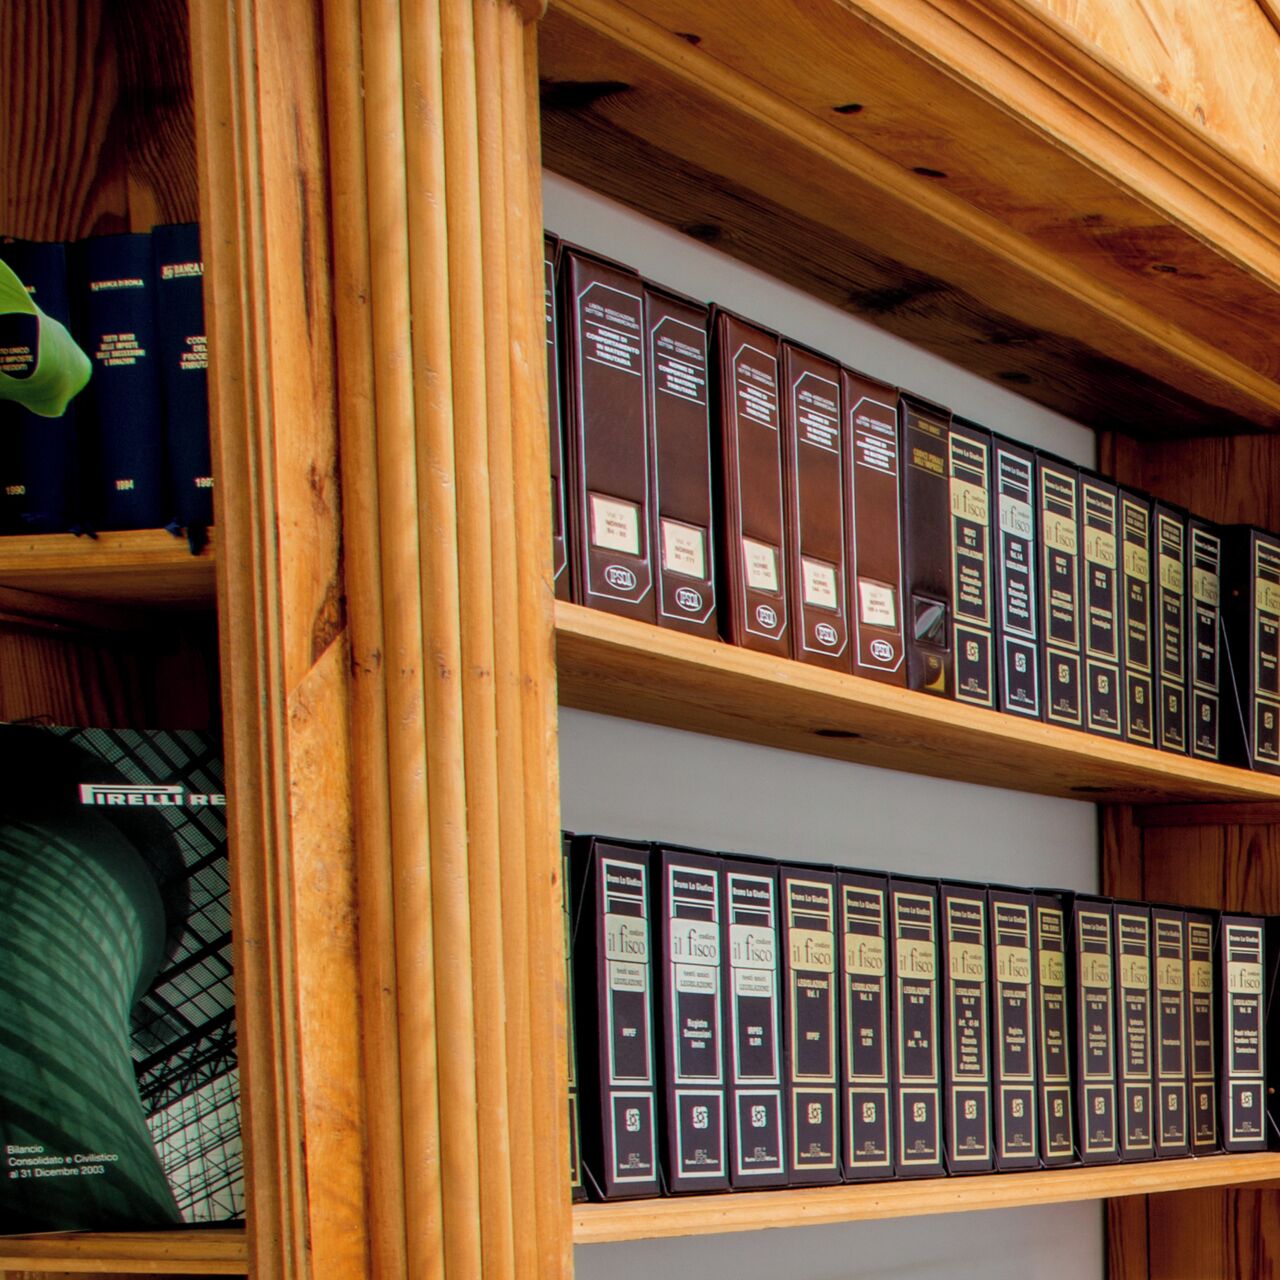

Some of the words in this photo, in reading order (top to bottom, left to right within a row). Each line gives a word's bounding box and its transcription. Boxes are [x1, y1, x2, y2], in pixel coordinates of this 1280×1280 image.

[586, 332, 640, 355] COMPORTAMENTO
[609, 568, 633, 588] IPSOA
[79, 784, 184, 806] PIRELLI
[608, 932, 616, 952] il
[620, 924, 645, 956] fisco
[674, 936, 683, 956] il
[688, 928, 717, 959] fisco
[734, 942, 742, 961] il
[745, 933, 773, 962] fisco
[793, 944, 801, 963] il
[805, 937, 832, 966] fisco
[848, 949, 856, 967] il
[859, 942, 883, 969] fisco
[899, 954, 907, 972] il
[911, 947, 933, 973] fisco
[6, 1144, 45, 1155] Bilancio
[8, 1156, 64, 1167] Consolidato
[65, 1156, 72, 1164] e
[74, 1152, 119, 1164] Civilistico
[9, 1169, 19, 1179] al
[20, 1169, 32, 1179] 31
[34, 1166, 79, 1177] Dicembre
[80, 1165, 105, 1175] 2003
